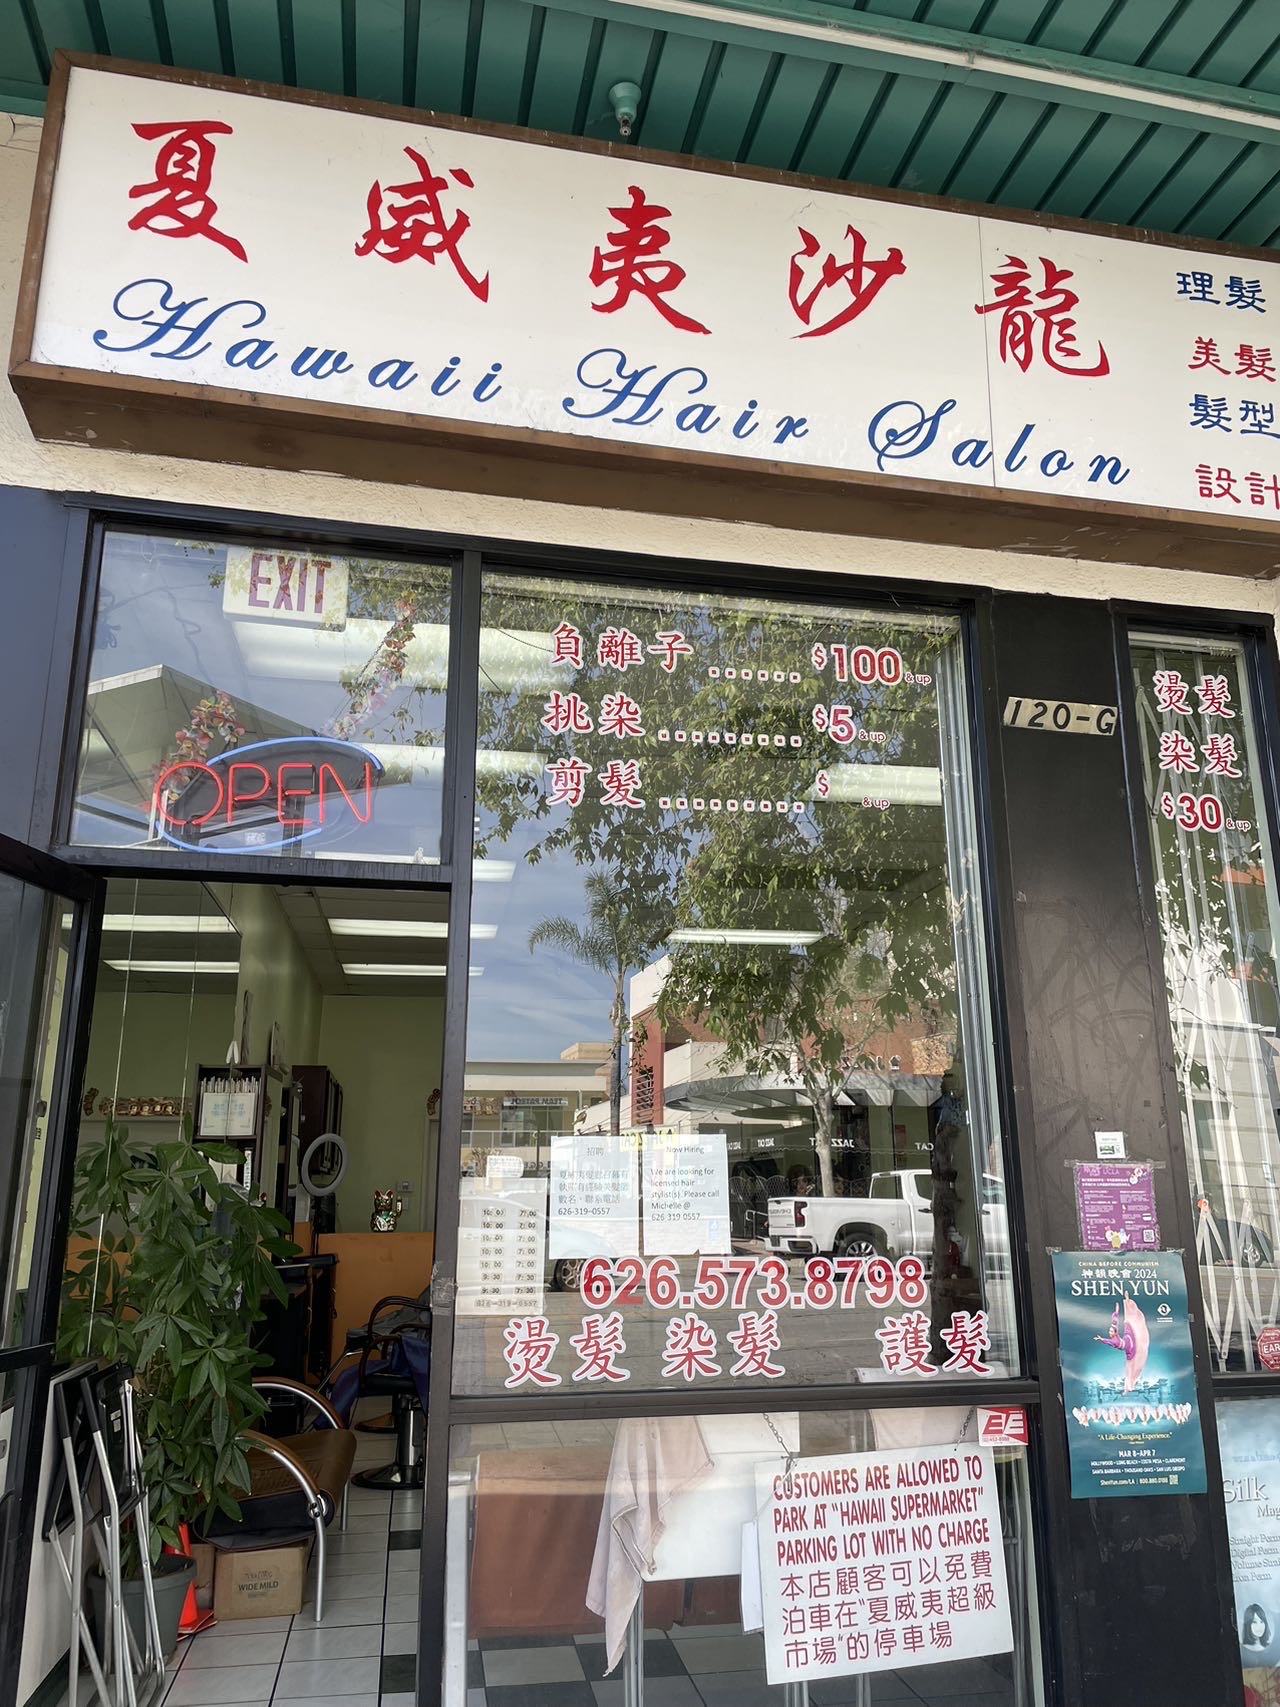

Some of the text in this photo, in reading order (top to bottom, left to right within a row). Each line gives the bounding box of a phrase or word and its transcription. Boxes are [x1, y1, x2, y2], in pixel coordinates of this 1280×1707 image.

[128, 121, 1110, 377] 夏威夷沙龍
[1177, 271, 1266, 313] 理髮
[94, 279, 1130, 485] Hawaii Hair Salon
[1188, 336, 1277, 383] 美髮
[1189, 393, 1279, 438] 髮型
[1195, 464, 1280, 511] 設計
[248, 552, 331, 615] EXIT
[551, 622, 694, 673] 負離子
[814, 646, 901, 684] $100
[543, 693, 645, 738] 挑染
[815, 708, 853, 742] $5
[1010, 700, 1116, 735] 120-G
[1154, 672, 1235, 718] 燙髮
[1161, 732, 1242, 776] 染髮
[155, 761, 372, 826] OPEN
[547, 758, 645, 807] 剪髮
[818, 774, 829, 796] $
[1163, 795, 1222, 830] $30
[681, 1179, 695, 1188] hair
[704, 1167, 715, 1176] for
[707, 1189, 720, 1198] call
[558, 1207, 611, 1216] 626-319-0557
[583, 1258, 926, 1309] 626.573.8798
[1071, 1280, 1170, 1296] SHEN YUN
[1134, 1269, 1158, 1279] 2024
[505, 1314, 990, 1384] 燙髮 染髮 護髮
[773, 1455, 983, 1501] CUSTOMERS ARE ALLOWED TO
[1223, 1476, 1269, 1504] Silk
[774, 1505, 808, 1533] PARK
[814, 1503, 828, 1530] AT
[777, 1518, 990, 1567] PARKING LOT WITH NO CHARGE
[239, 1581, 278, 1591] WIDE MILD
[780, 1551, 993, 1601] 本店顧客可以免費
